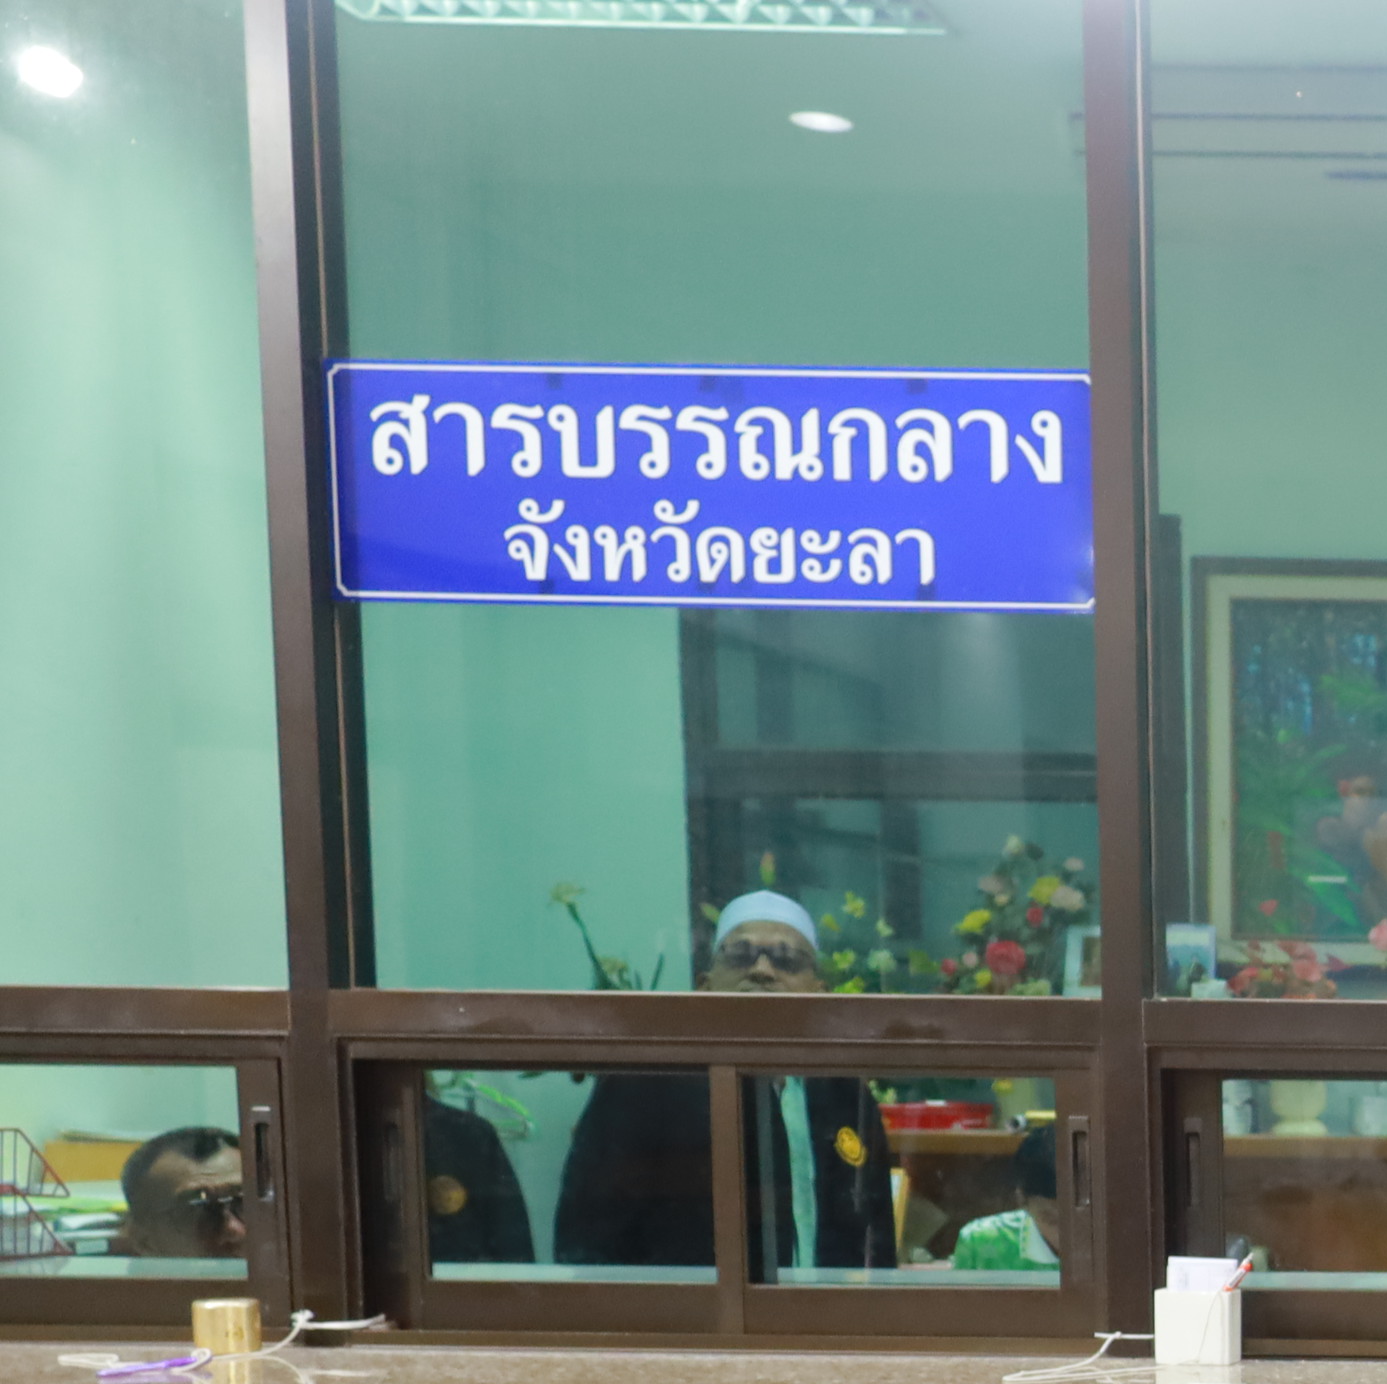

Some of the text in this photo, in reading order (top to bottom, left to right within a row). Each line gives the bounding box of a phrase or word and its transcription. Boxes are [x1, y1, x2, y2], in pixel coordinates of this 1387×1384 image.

[369, 394, 1064, 484] สารบรรณกลาง
[502, 498, 936, 586] จังหวัดยะลา
